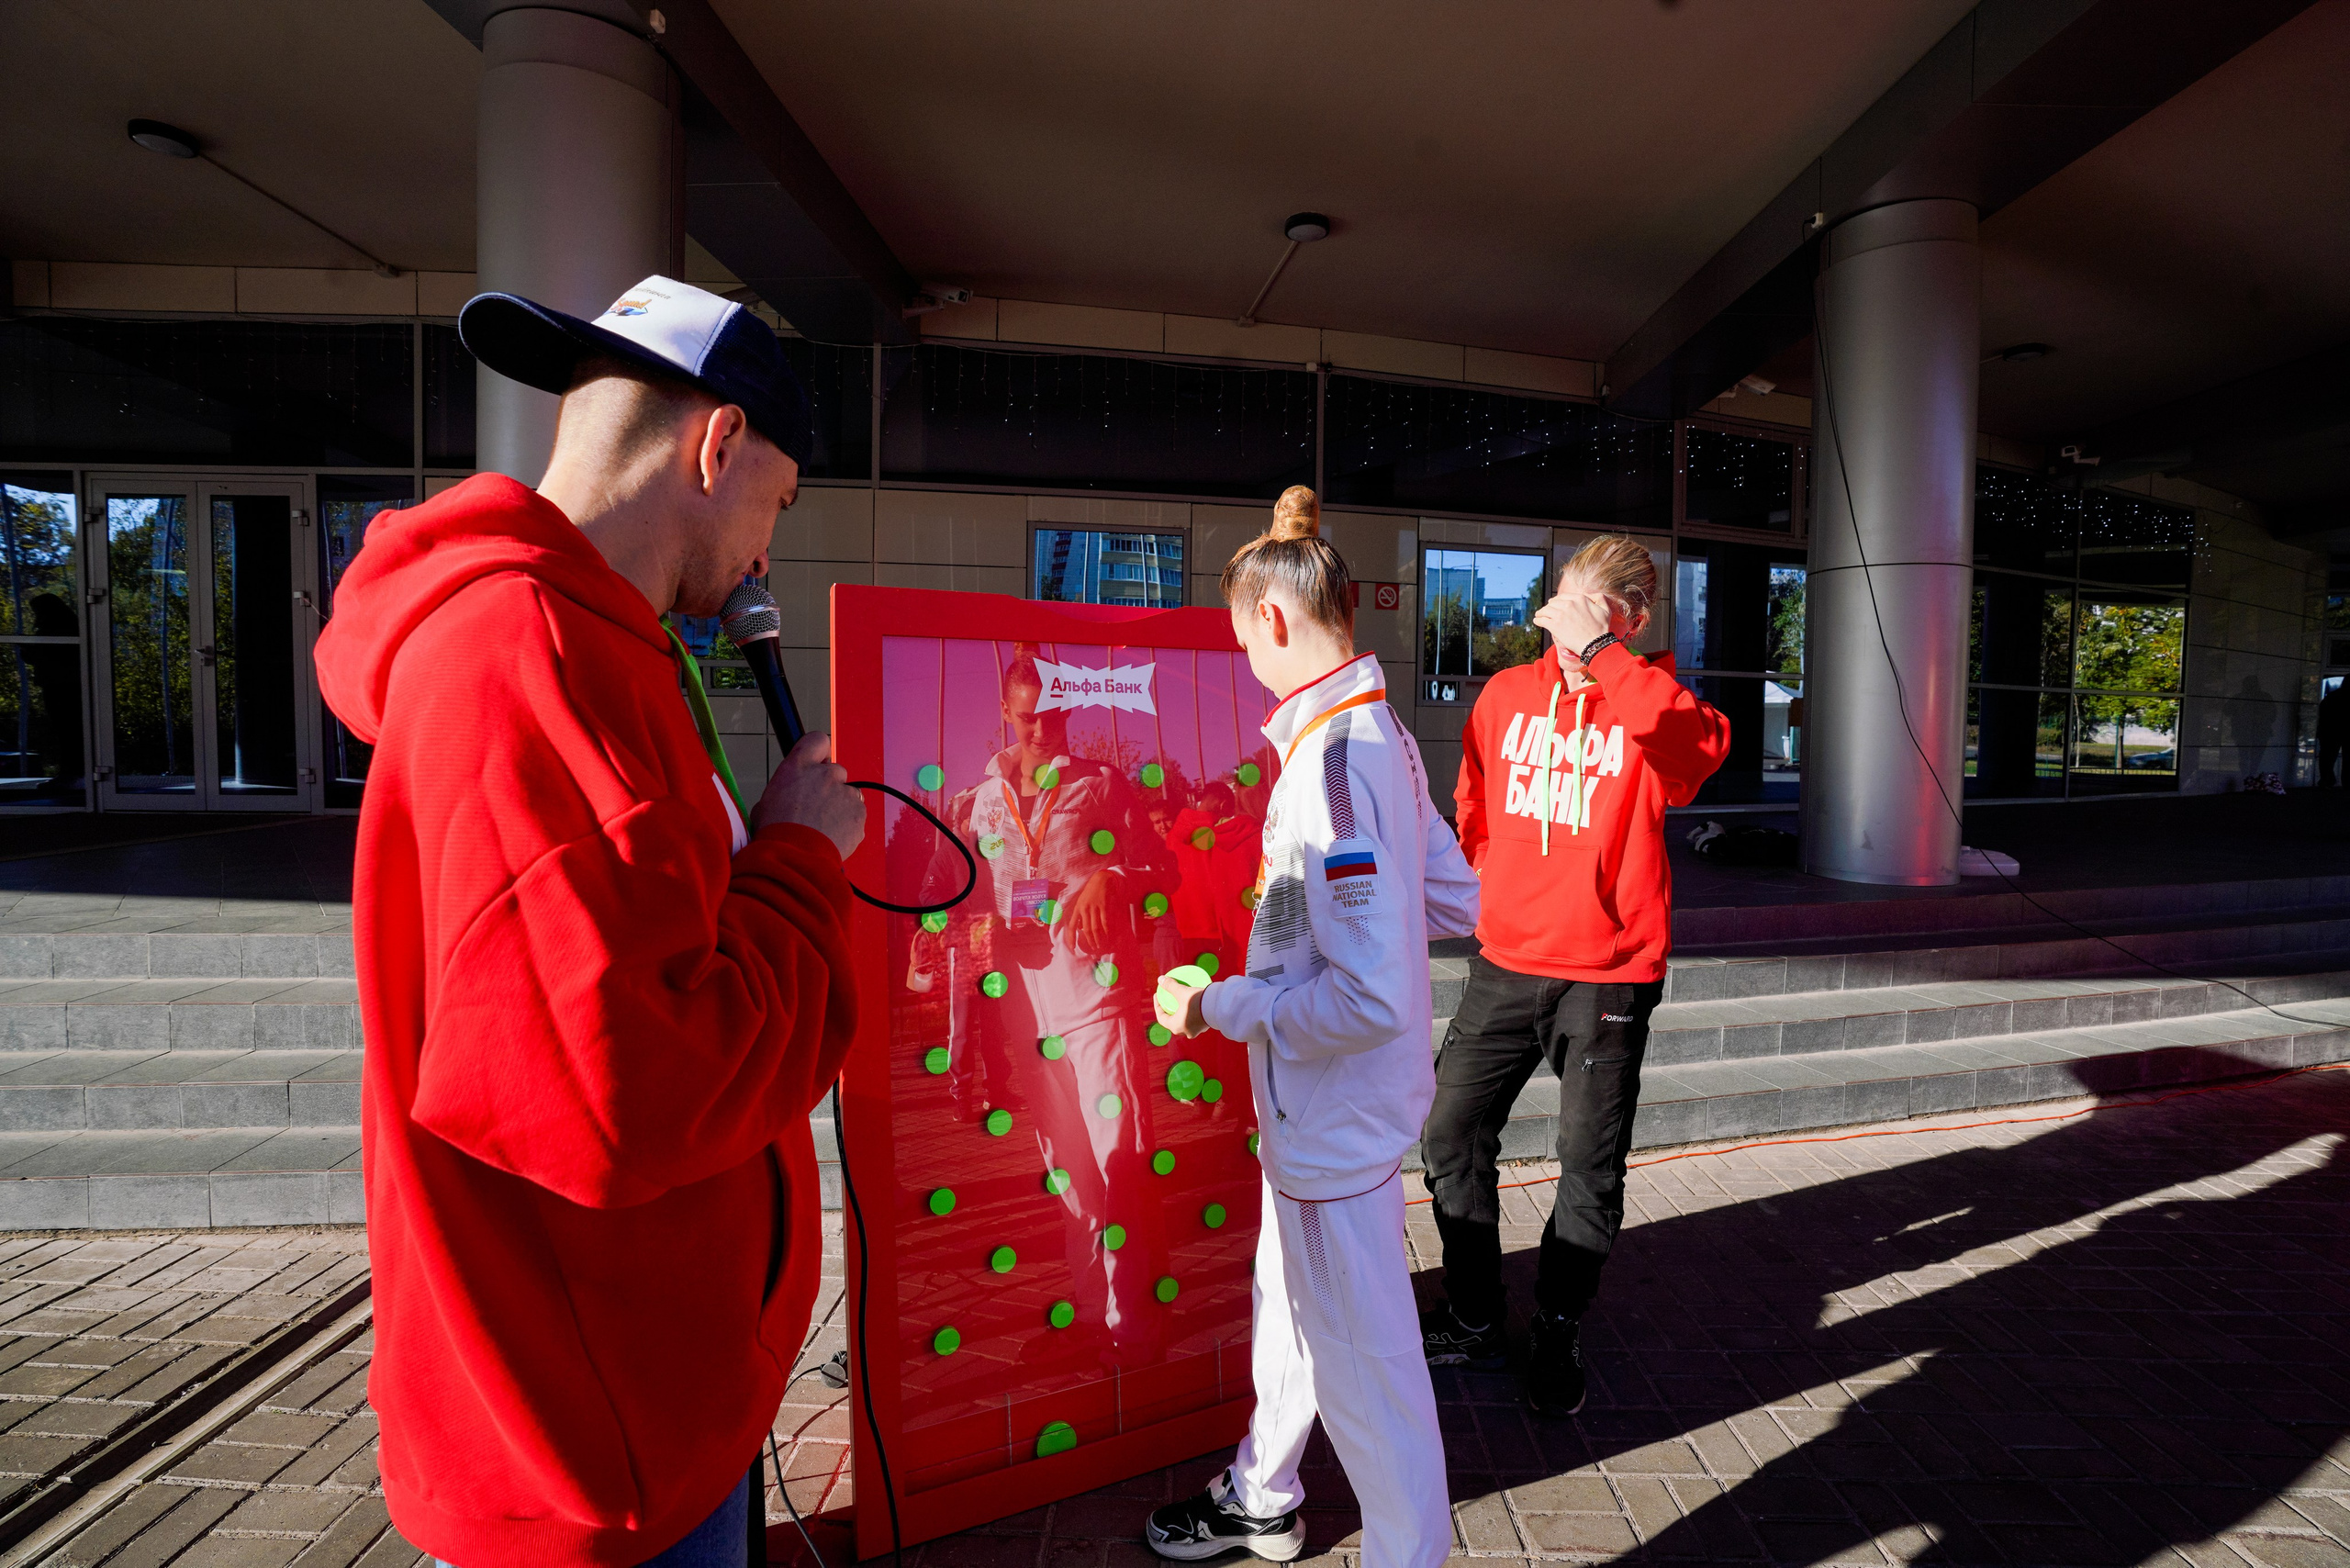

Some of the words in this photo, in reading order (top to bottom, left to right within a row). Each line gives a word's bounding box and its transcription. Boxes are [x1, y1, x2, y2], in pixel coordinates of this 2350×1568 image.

[1050, 677, 1102, 698] Альфа
[1104, 678, 1143, 694] Банк
[1501, 712, 1624, 777] АЛЬФА
[1505, 764, 1600, 828] БАНК
[1334, 880, 1371, 893] RUSSIAN
[1332, 890, 1377, 902] NATIONAL
[1341, 898, 1369, 908] TEAM
[1601, 1013, 1634, 1023] FORWARD
